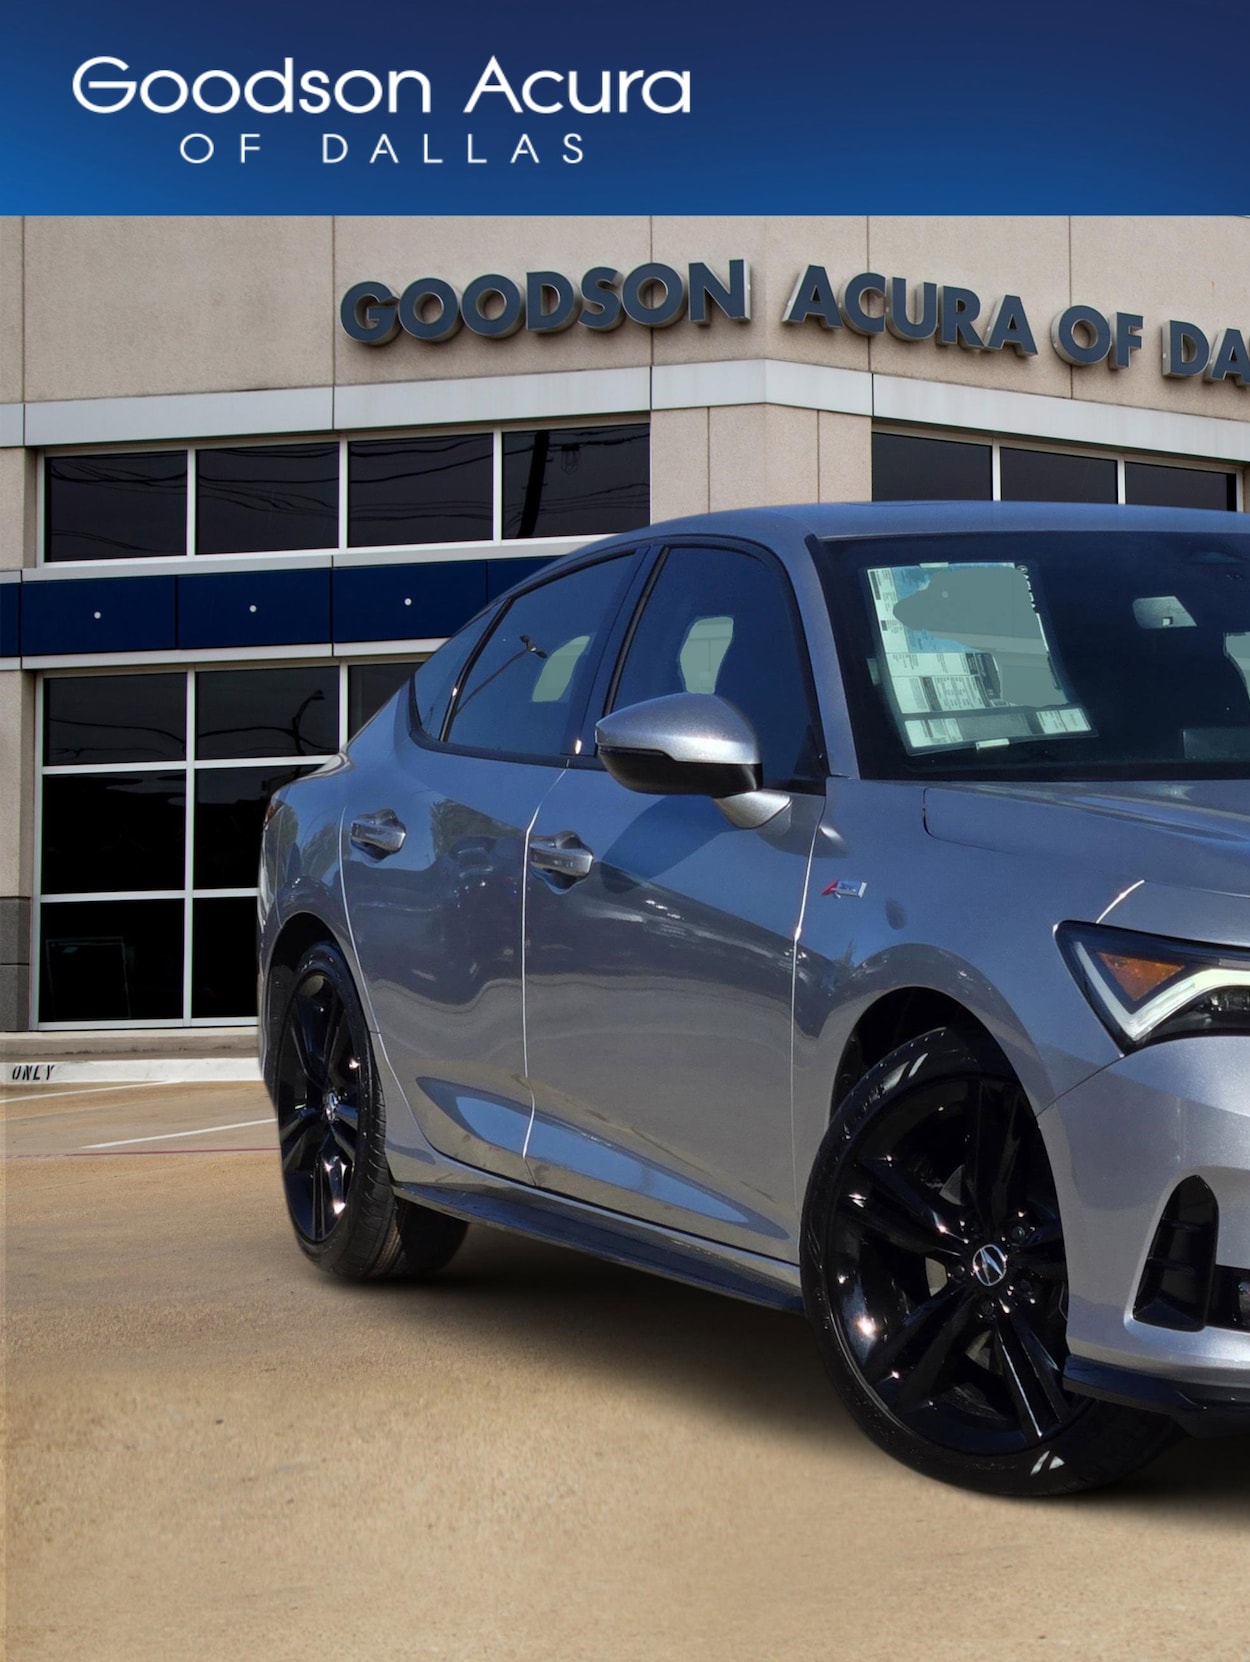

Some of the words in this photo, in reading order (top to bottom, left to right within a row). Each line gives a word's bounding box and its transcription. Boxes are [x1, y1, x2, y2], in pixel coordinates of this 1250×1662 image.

[340, 259, 751, 346] GOODSON
[782, 264, 1038, 357] ACURA
[1051, 304, 1144, 368] OF
[11, 1064, 56, 1081] ONLY
